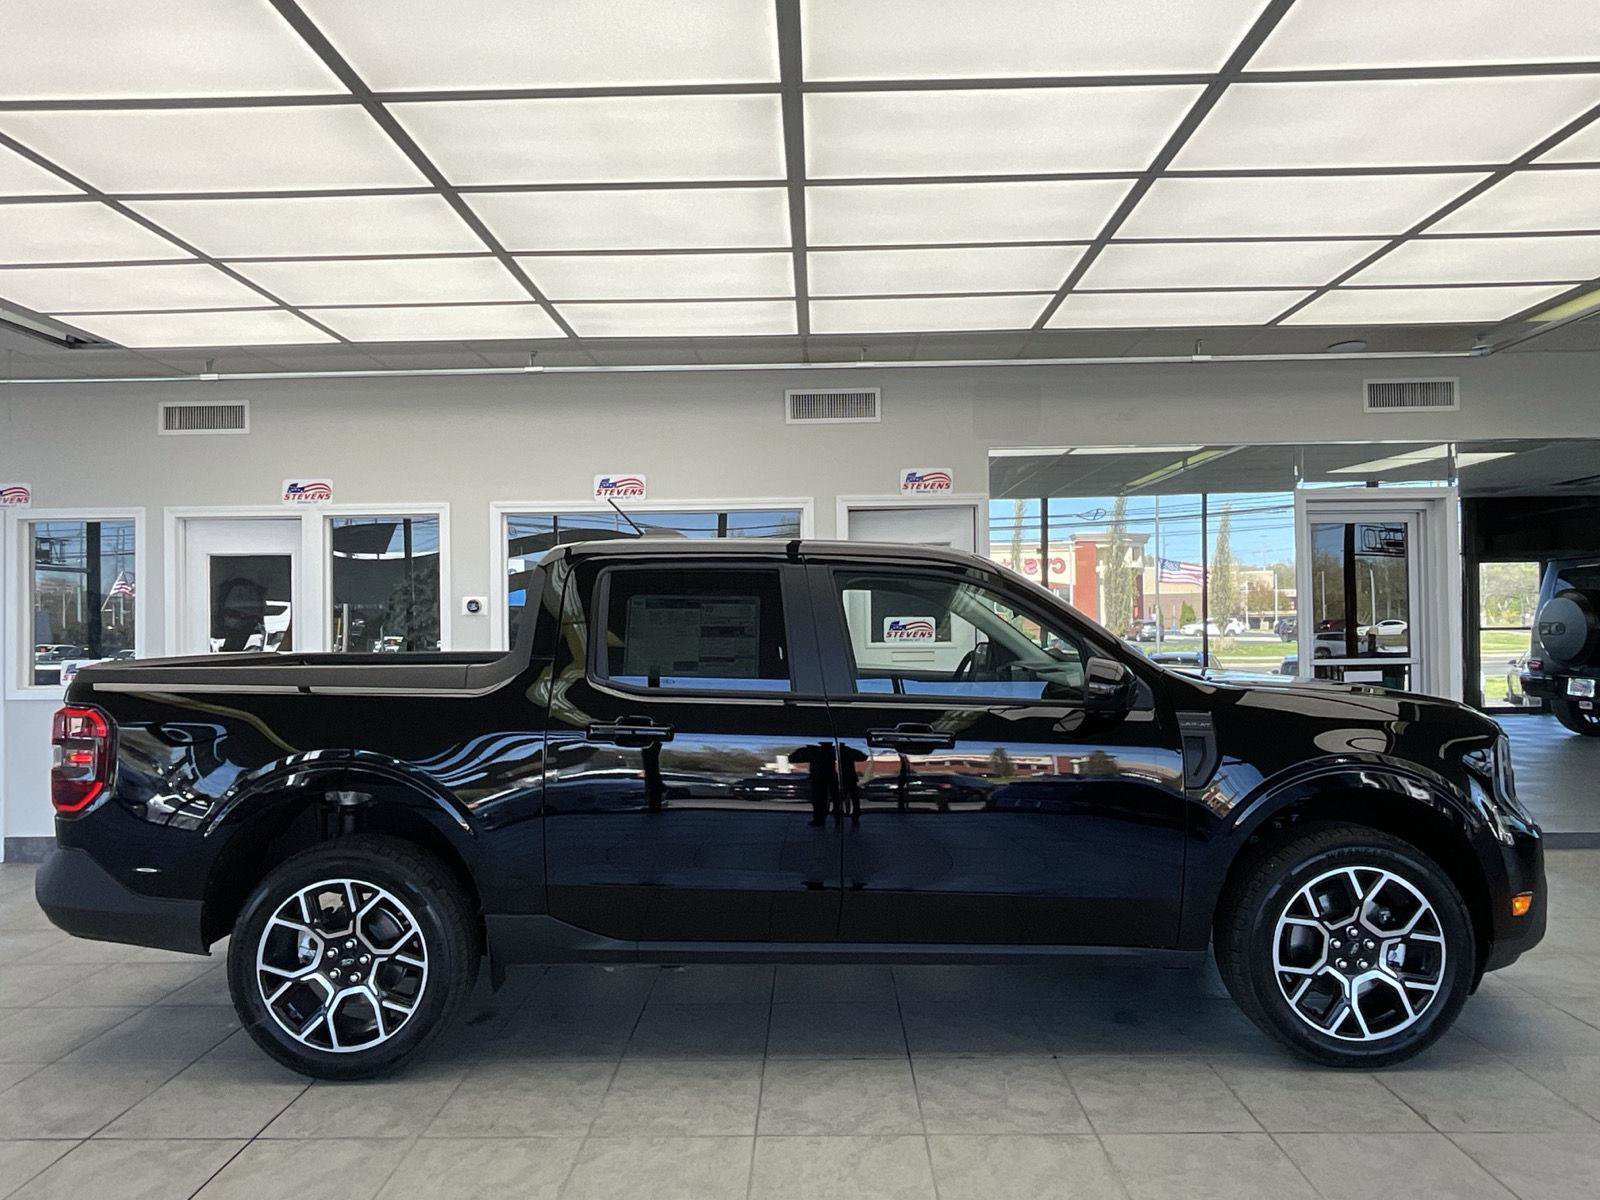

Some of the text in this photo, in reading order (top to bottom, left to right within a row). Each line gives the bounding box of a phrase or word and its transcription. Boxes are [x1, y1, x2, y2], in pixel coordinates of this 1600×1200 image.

[902, 482, 951, 490] STEVENS
[595, 488, 644, 496] STEVENS
[284, 493, 331, 501] STEVENS
[886, 630, 933, 638] STEVENS
